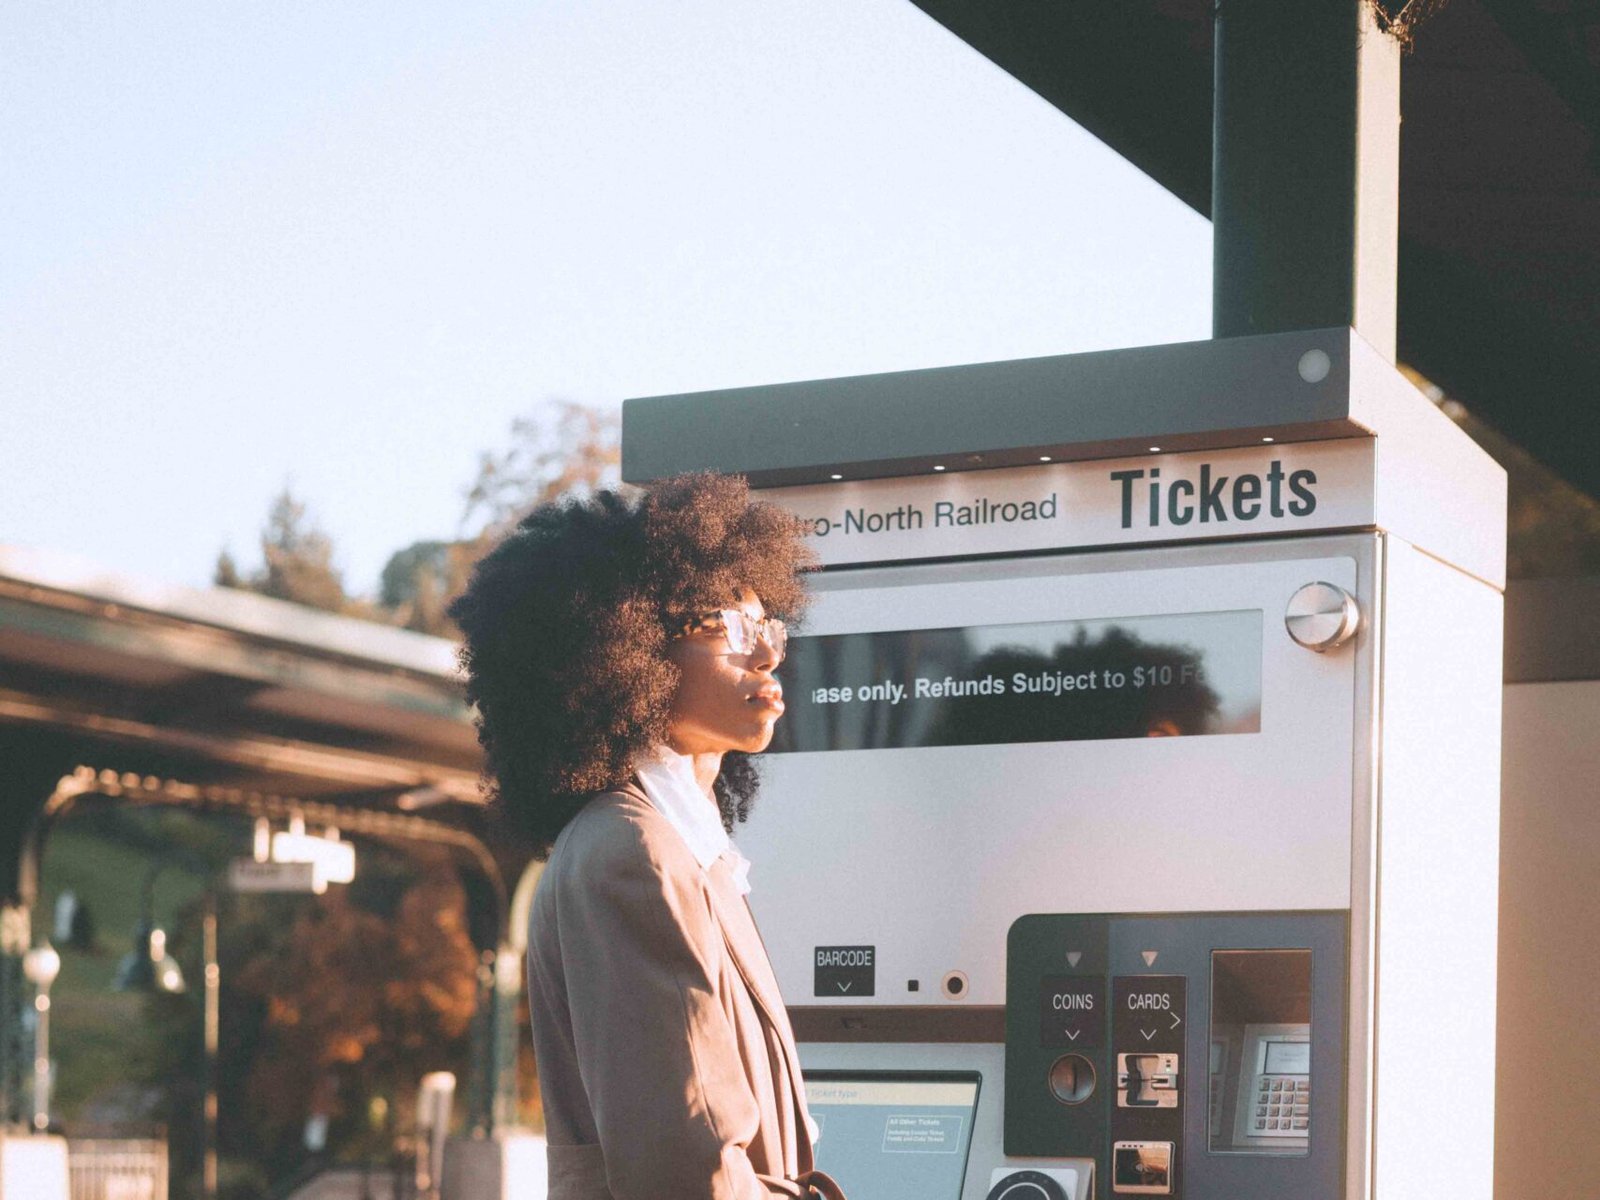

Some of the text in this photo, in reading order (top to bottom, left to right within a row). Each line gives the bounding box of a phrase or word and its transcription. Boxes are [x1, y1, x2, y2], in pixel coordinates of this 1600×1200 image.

[1110, 460, 1317, 528] Tickets
[934, 493, 1057, 527] Railroad
[812, 686, 853, 704] ase
[857, 680, 908, 705] only.
[915, 674, 1005, 699] Refunds
[1012, 670, 1097, 696] Subject
[1103, 669, 1126, 688] to
[1133, 665, 1173, 688] $10
[817, 950, 872, 966] BARCODE
[1052, 993, 1093, 1010] COINS
[1127, 993, 1170, 1010] CARDS
